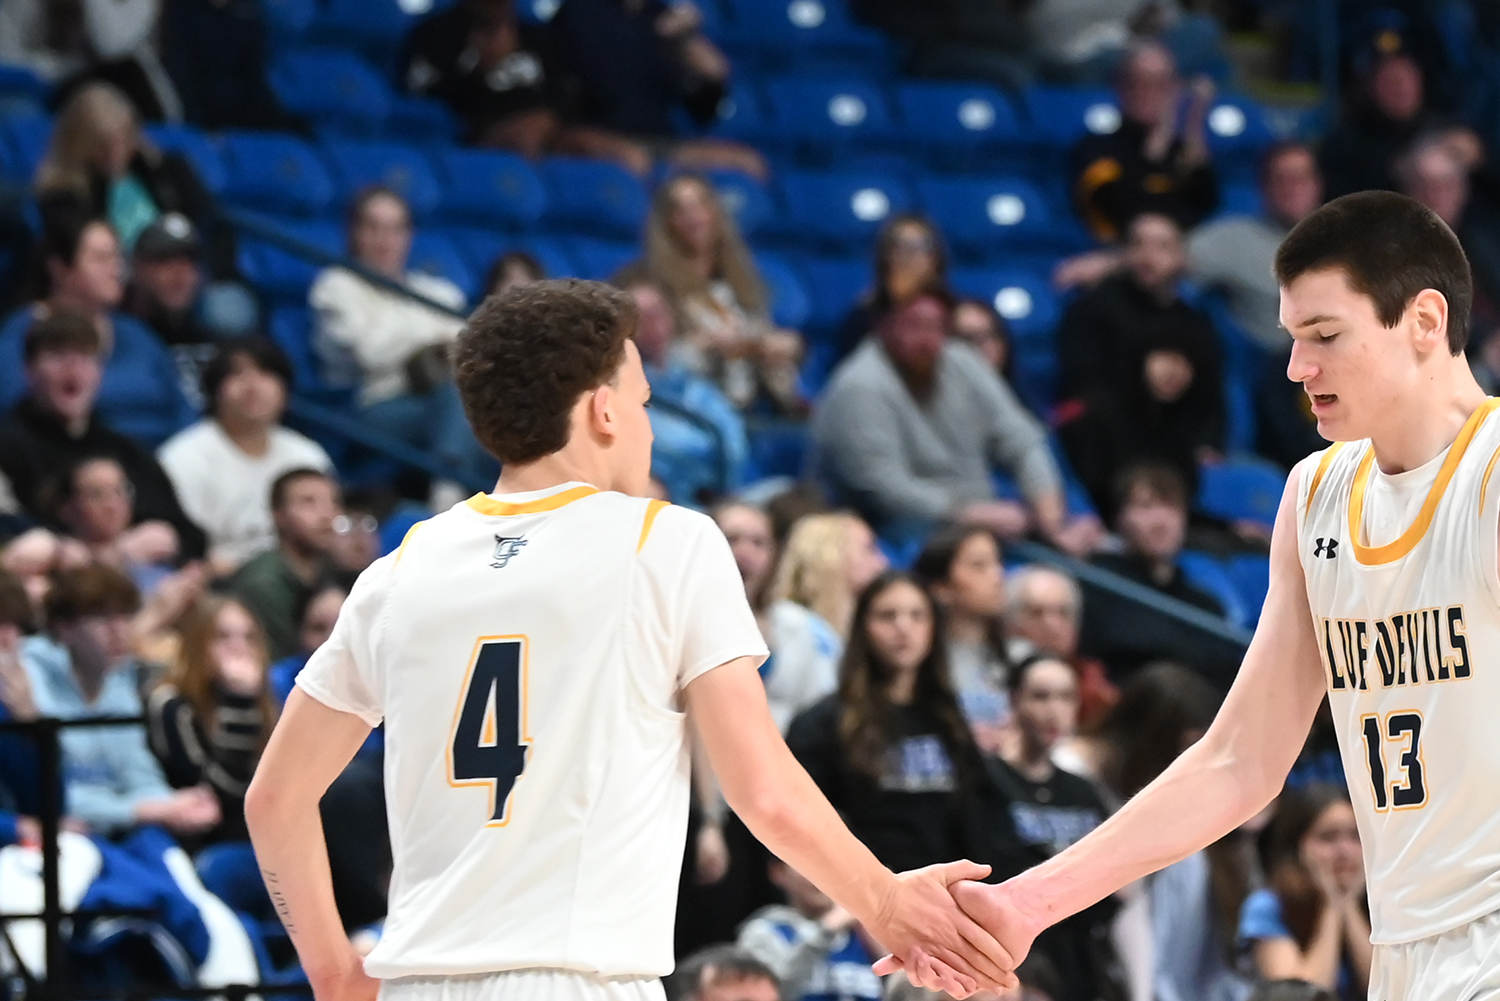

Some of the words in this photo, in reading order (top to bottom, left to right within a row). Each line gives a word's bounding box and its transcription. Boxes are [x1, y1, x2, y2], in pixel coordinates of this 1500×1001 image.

[1321, 617, 1371, 692] LUE
[1373, 603, 1473, 689] DEVILS
[446, 634, 533, 828] 4
[1360, 708, 1429, 813] 13
